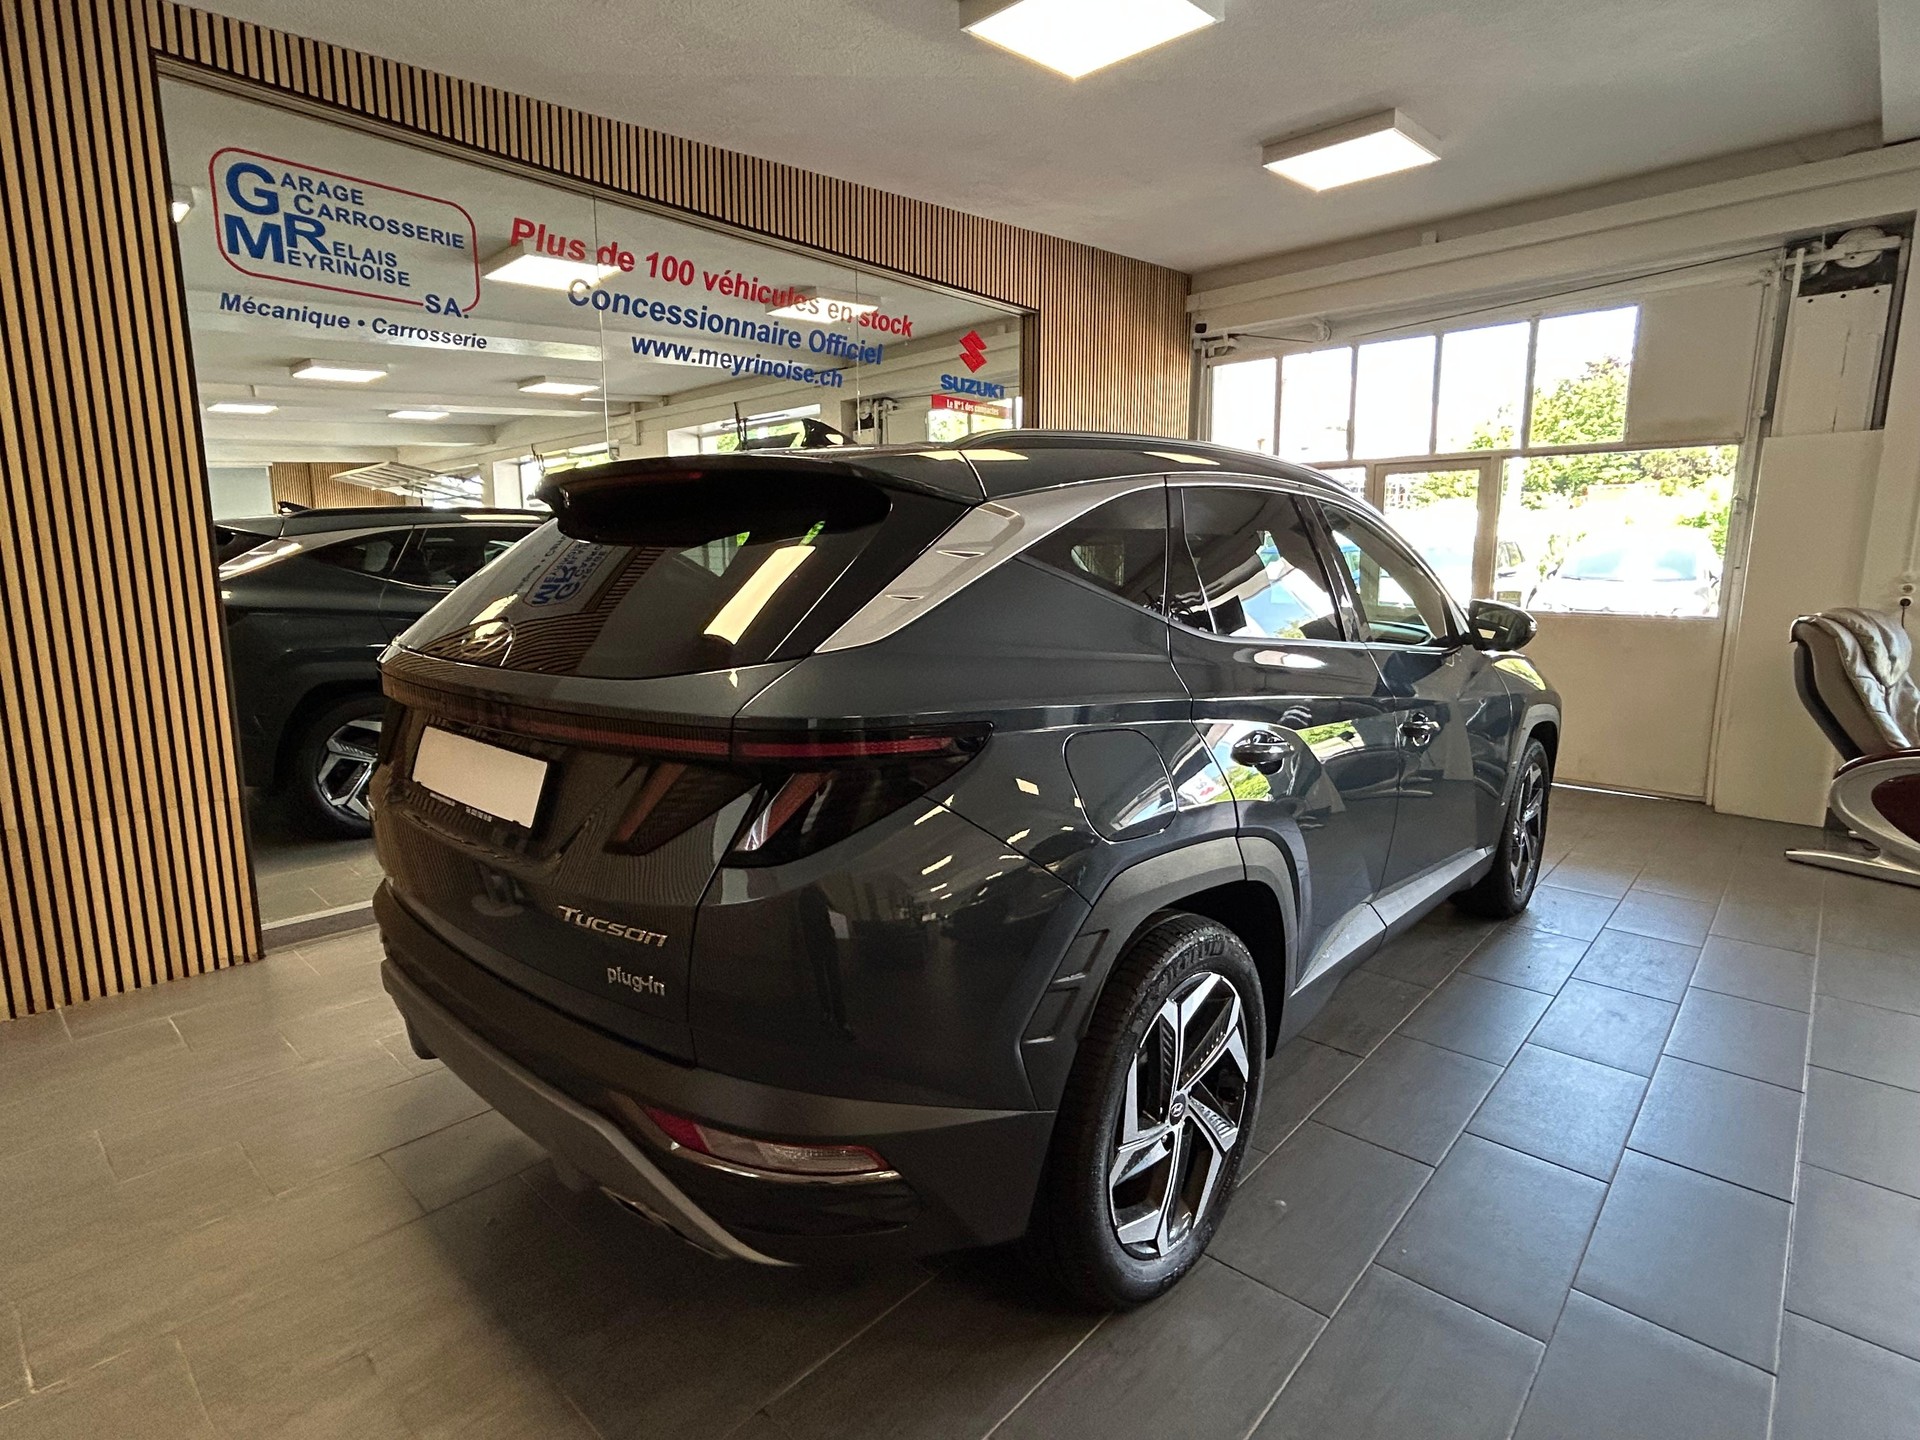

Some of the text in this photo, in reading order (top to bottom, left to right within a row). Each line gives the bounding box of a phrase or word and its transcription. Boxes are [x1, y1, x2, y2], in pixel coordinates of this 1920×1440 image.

[226, 162, 364, 215] GARAGE
[284, 212, 398, 267] RELAIS
[294, 194, 465, 249] CARROSSERIE
[224, 214, 411, 287] MEYRINOISE
[510, 217, 914, 338] Plus de 100 véhicules en stock
[219, 292, 488, 349] Mécanique Carrosserie
[567, 278, 884, 365] Concessionnaire Officiel
[631, 336, 843, 388] www.meyrinoise.ch
[940, 373, 1004, 399] SUZUKI
[607, 966, 665, 996] plug-in
